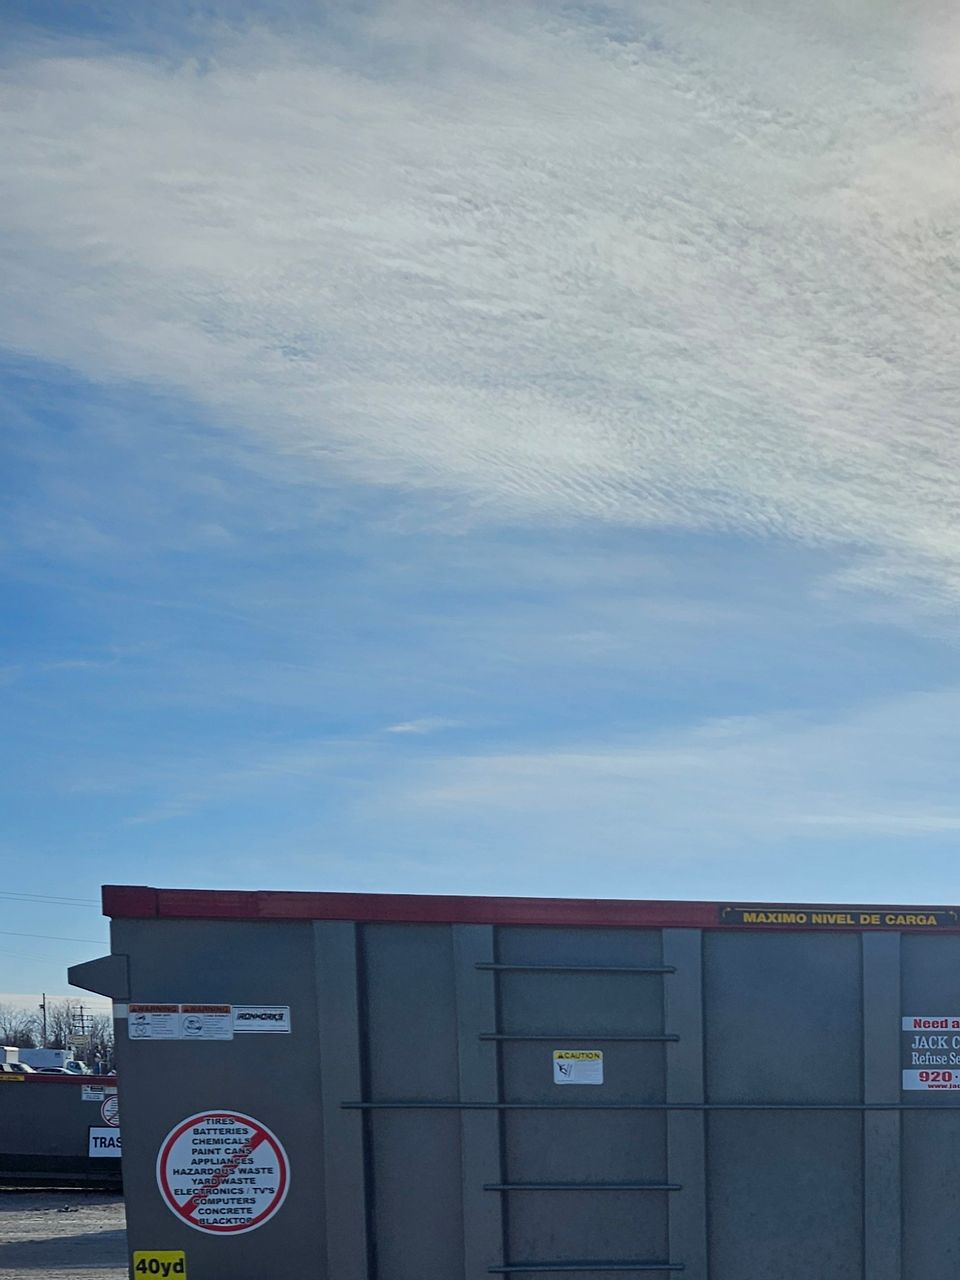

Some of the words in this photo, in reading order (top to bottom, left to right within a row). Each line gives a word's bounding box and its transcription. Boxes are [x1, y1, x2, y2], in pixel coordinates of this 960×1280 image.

[743, 912, 807, 924] MAXIMO
[812, 913, 855, 925] NIVEL
[860, 914, 880, 925] DE
[885, 914, 937, 926] CARGA
[913, 1019, 948, 1029] Need
[952, 1020, 960, 1029] a
[911, 1035, 948, 1049] JACK
[564, 1052, 600, 1060] CAUTION
[911, 1052, 947, 1065] Refuse
[224, 1147, 252, 1155] CANS
[238, 1167, 274, 1175] WASTE
[174, 1188, 244, 1196] ELECTRONICS
[193, 1197, 256, 1205] COMPUTERS
[198, 1207, 253, 1215] CONCRETE
[199, 1217, 253, 1225] BLACKTOP
[135, 1257, 185, 1278] 40yd
